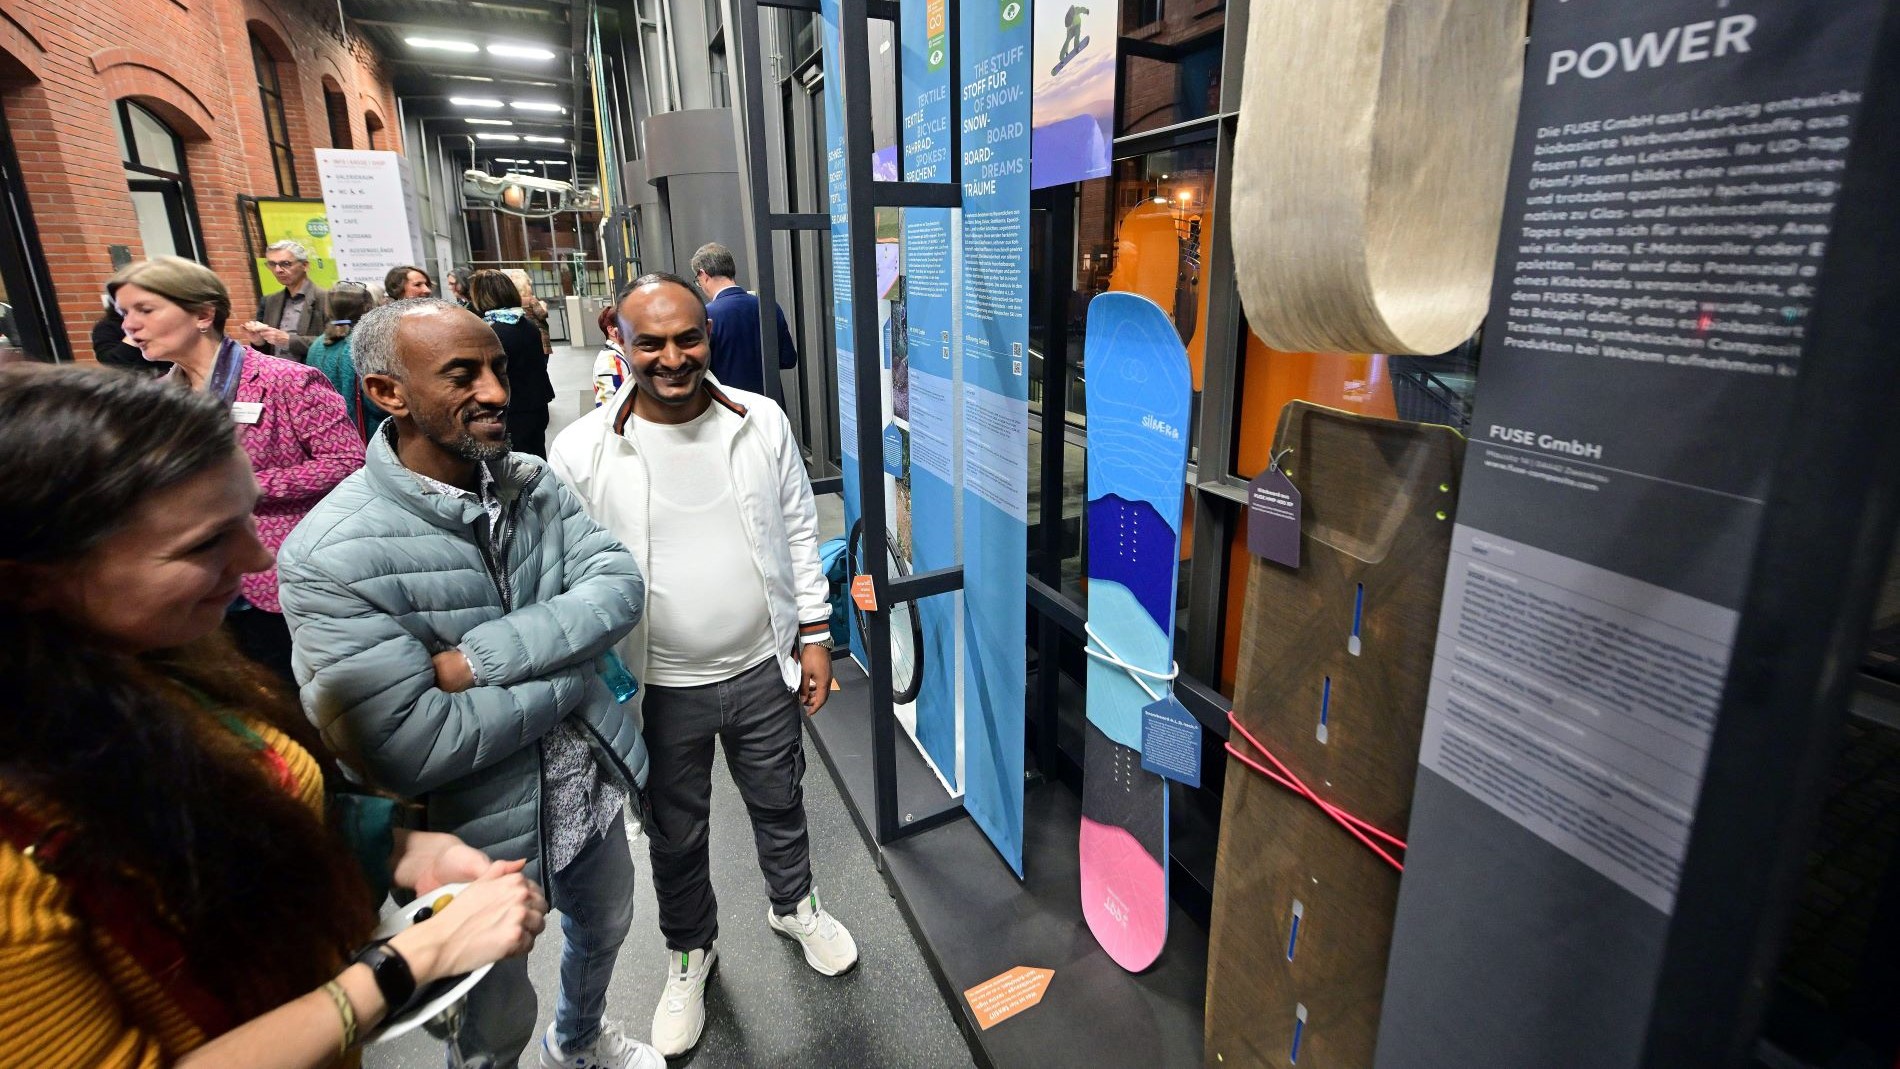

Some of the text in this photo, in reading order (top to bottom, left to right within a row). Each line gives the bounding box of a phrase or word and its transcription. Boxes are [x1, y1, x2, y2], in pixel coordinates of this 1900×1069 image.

[1546, 14, 1758, 85] POWER
[974, 46, 1024, 80] THE STUFF
[963, 69, 1006, 100] STOFF FÜR
[918, 85, 946, 108] TEXTILE
[974, 85, 1024, 114] OF SNOW-
[918, 116, 946, 138] BICYCLE
[964, 113, 991, 134] SNOW-
[1537, 126, 1561, 138] Die
[1563, 120, 1601, 134] FUSE
[1602, 114, 1654, 130] GmbH
[1656, 112, 1689, 124] aus
[1691, 102, 1761, 120] Leipzig
[987, 122, 1023, 144] BOARD
[964, 148, 994, 166] BOARD-
[1604, 154, 1636, 166] den
[982, 158, 1023, 178] DREAMS
[964, 179, 996, 197] TRÄUME
[1526, 193, 1553, 204] und
[1632, 206, 1666, 218] und
[1519, 243, 1542, 253] wie
[1627, 260, 1666, 272] wird
[1667, 260, 1701, 274] das
[1514, 275, 1548, 286] eines
[1511, 290, 1540, 302] dem
[1489, 425, 1602, 460] FUSE GmbH
